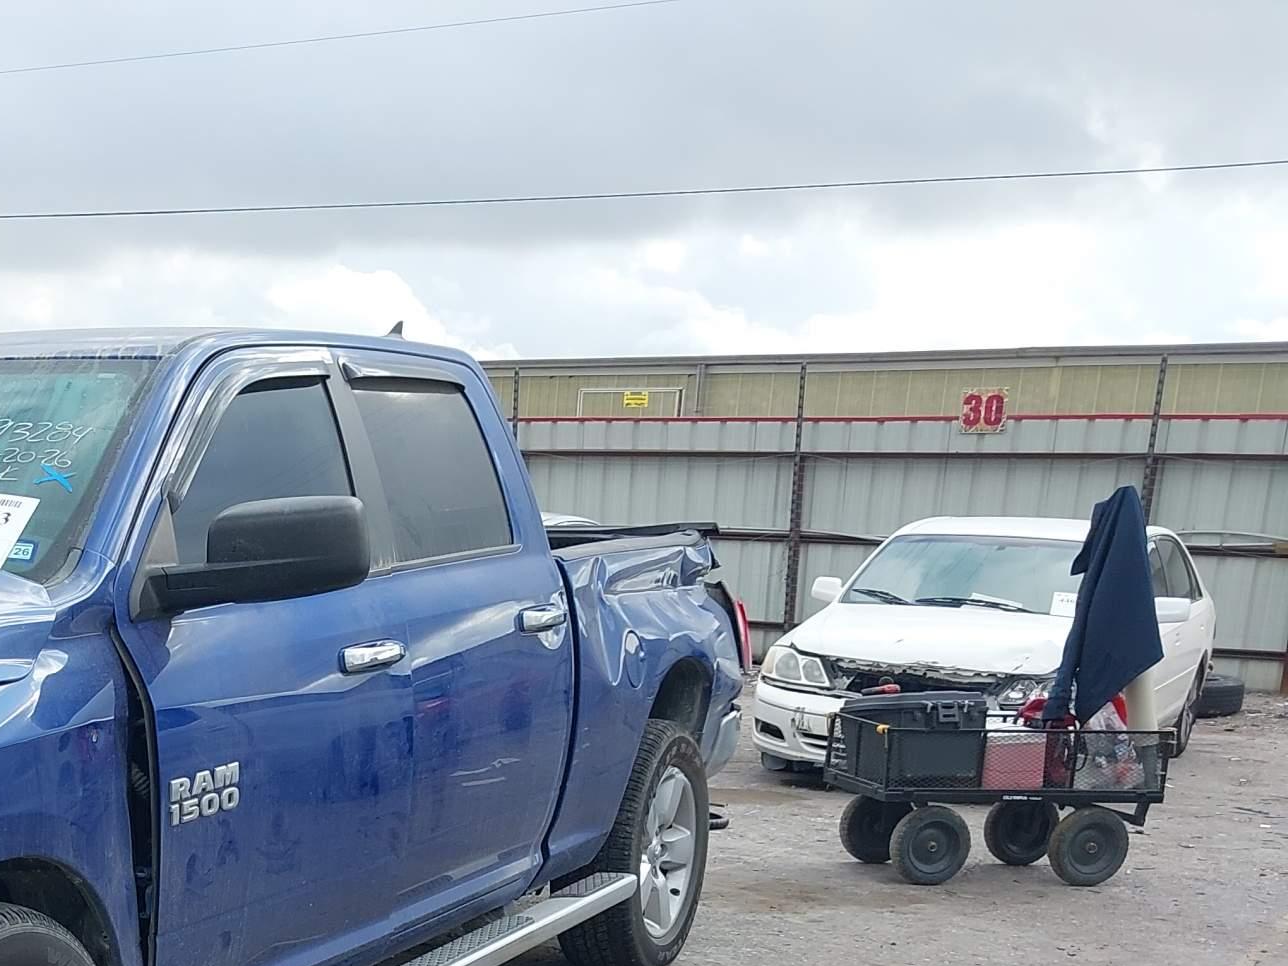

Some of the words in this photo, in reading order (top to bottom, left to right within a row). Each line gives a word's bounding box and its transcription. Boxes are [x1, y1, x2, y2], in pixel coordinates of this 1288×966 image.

[963, 394, 1004, 426] 30
[13, 547, 30, 556] 26
[169, 761, 240, 802] RAM
[168, 786, 240, 827] 1500
